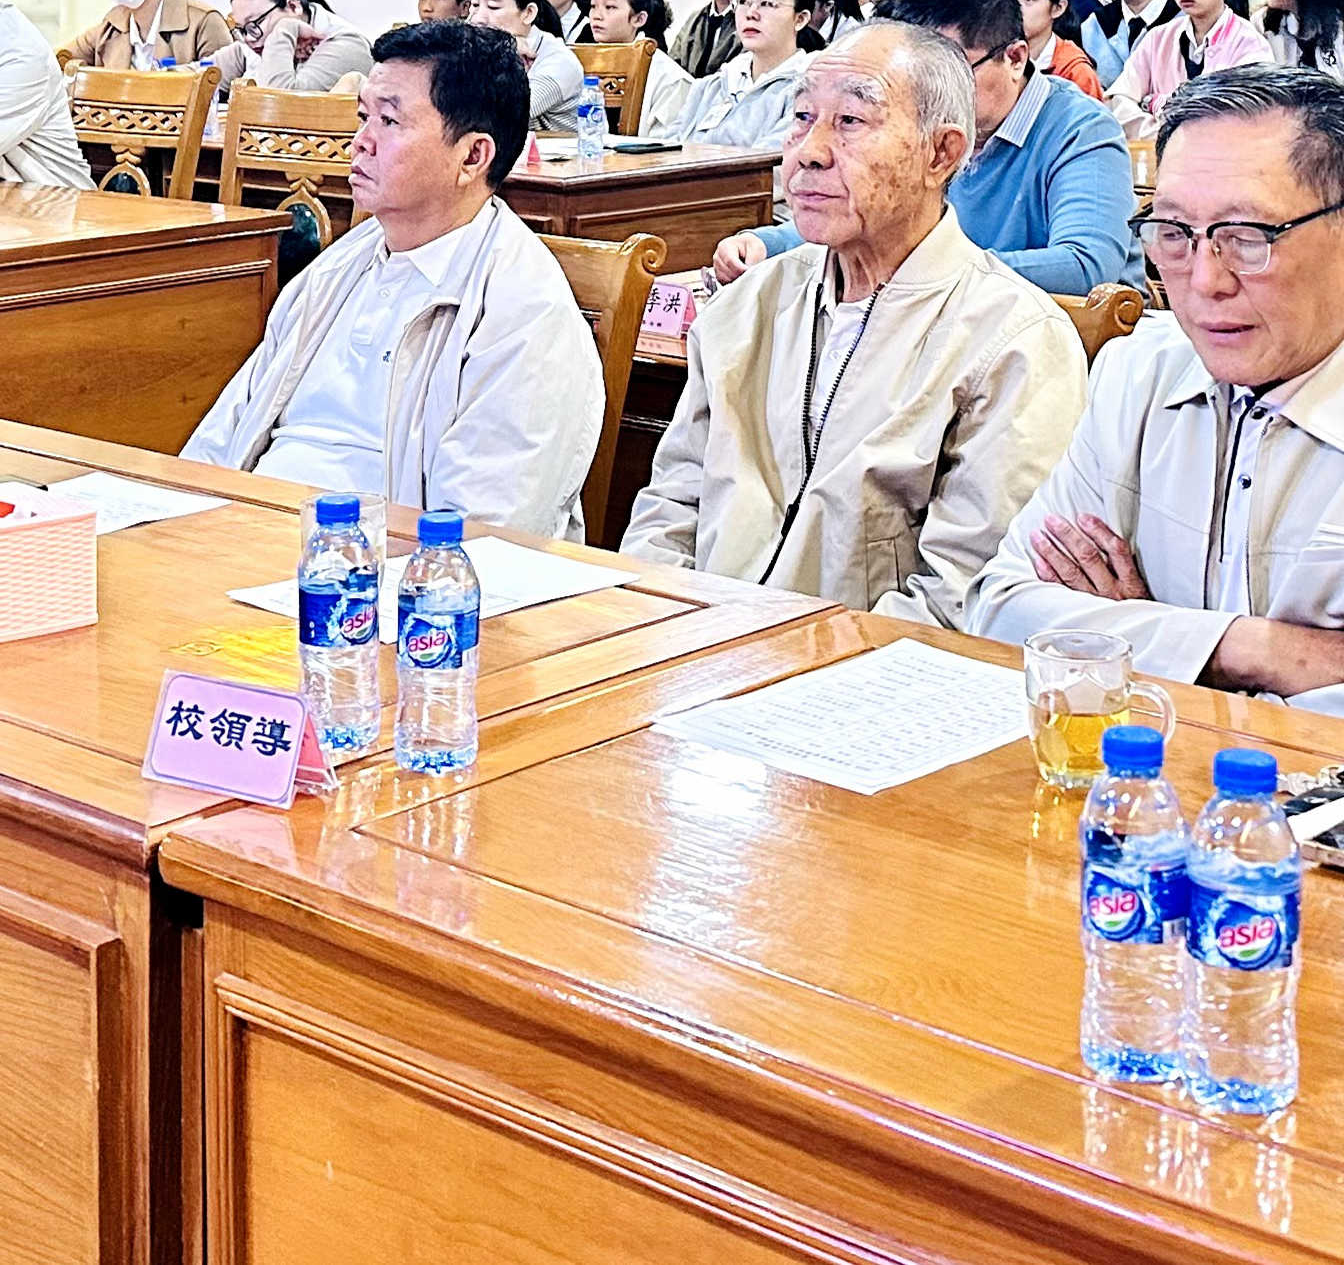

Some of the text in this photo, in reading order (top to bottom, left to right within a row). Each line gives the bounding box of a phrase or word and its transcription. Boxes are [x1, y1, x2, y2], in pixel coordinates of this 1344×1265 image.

[408, 630, 446, 653] asia
[165, 699, 293, 757] 校領導
[1089, 890, 1138, 916] asia
[1218, 916, 1276, 949] asia
